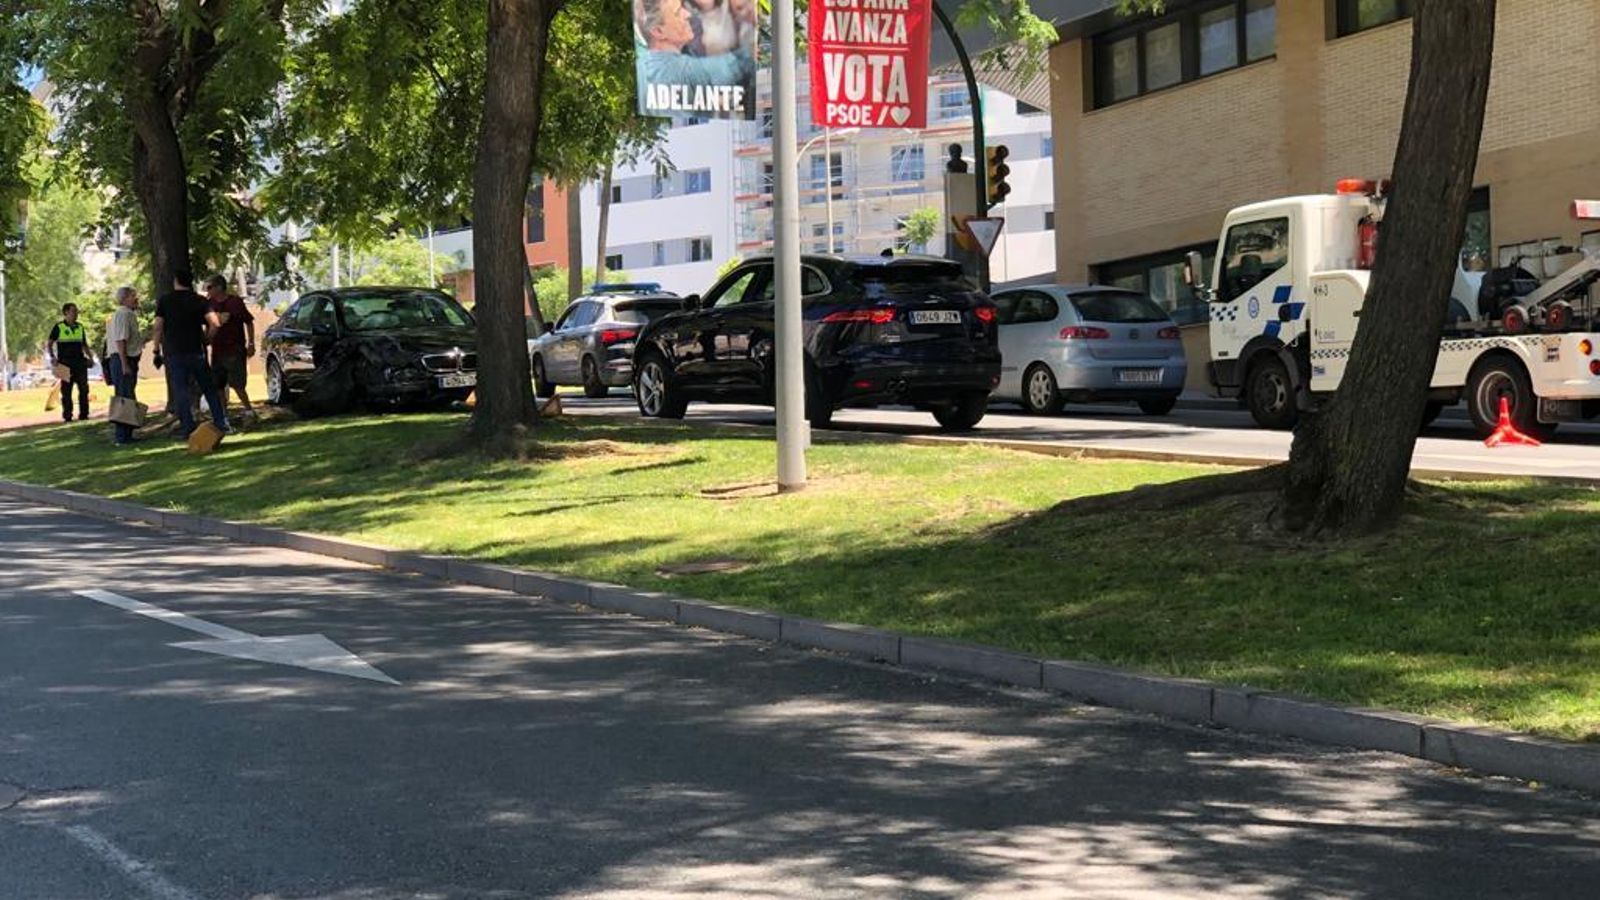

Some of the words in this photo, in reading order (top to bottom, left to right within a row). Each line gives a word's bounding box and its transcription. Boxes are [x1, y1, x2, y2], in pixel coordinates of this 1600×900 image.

[822, 10, 908, 44] AVANZA
[822, 53, 910, 103] VOTA
[646, 83, 745, 112] ADELANTE
[826, 103, 873, 126] PSOE
